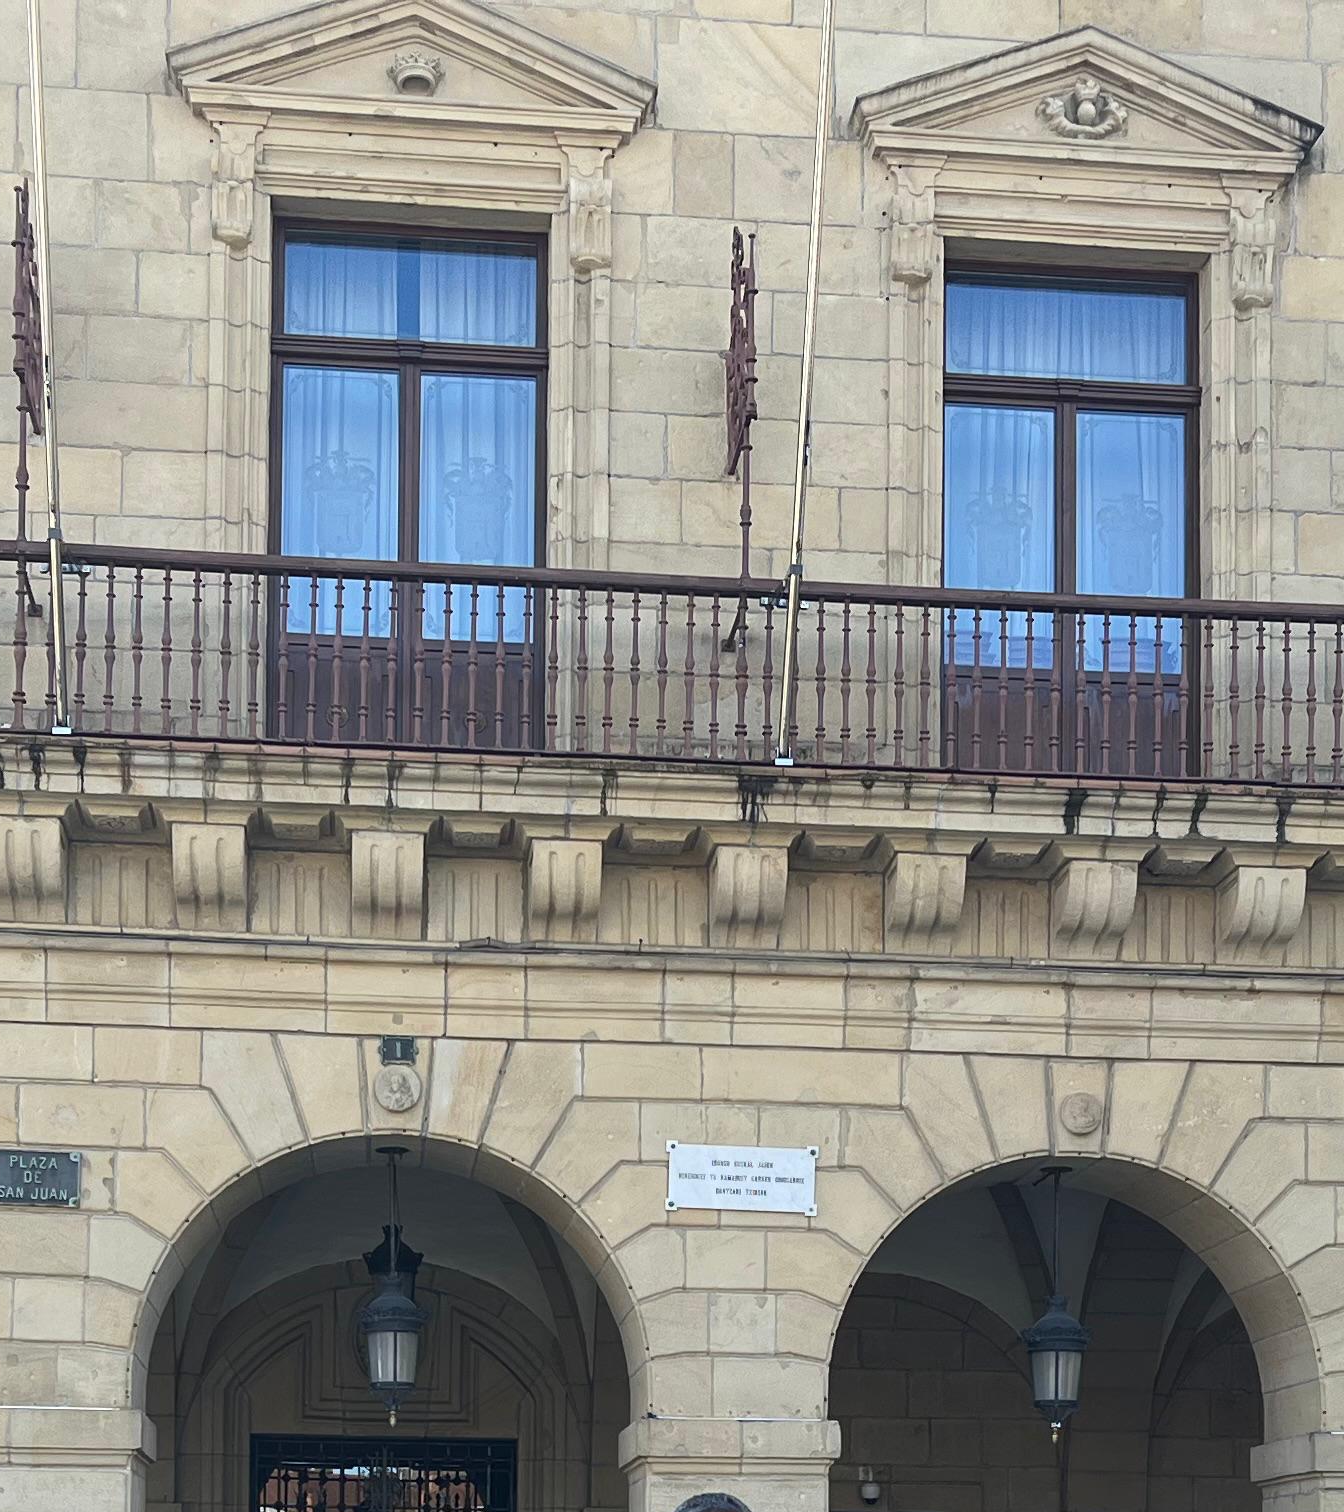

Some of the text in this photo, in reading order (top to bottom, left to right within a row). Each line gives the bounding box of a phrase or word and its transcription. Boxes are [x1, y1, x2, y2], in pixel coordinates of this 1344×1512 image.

[9, 1155, 58, 1169] PLAZA
[23, 1170, 42, 1184] DE
[30, 1188, 68, 1201] JUAN
